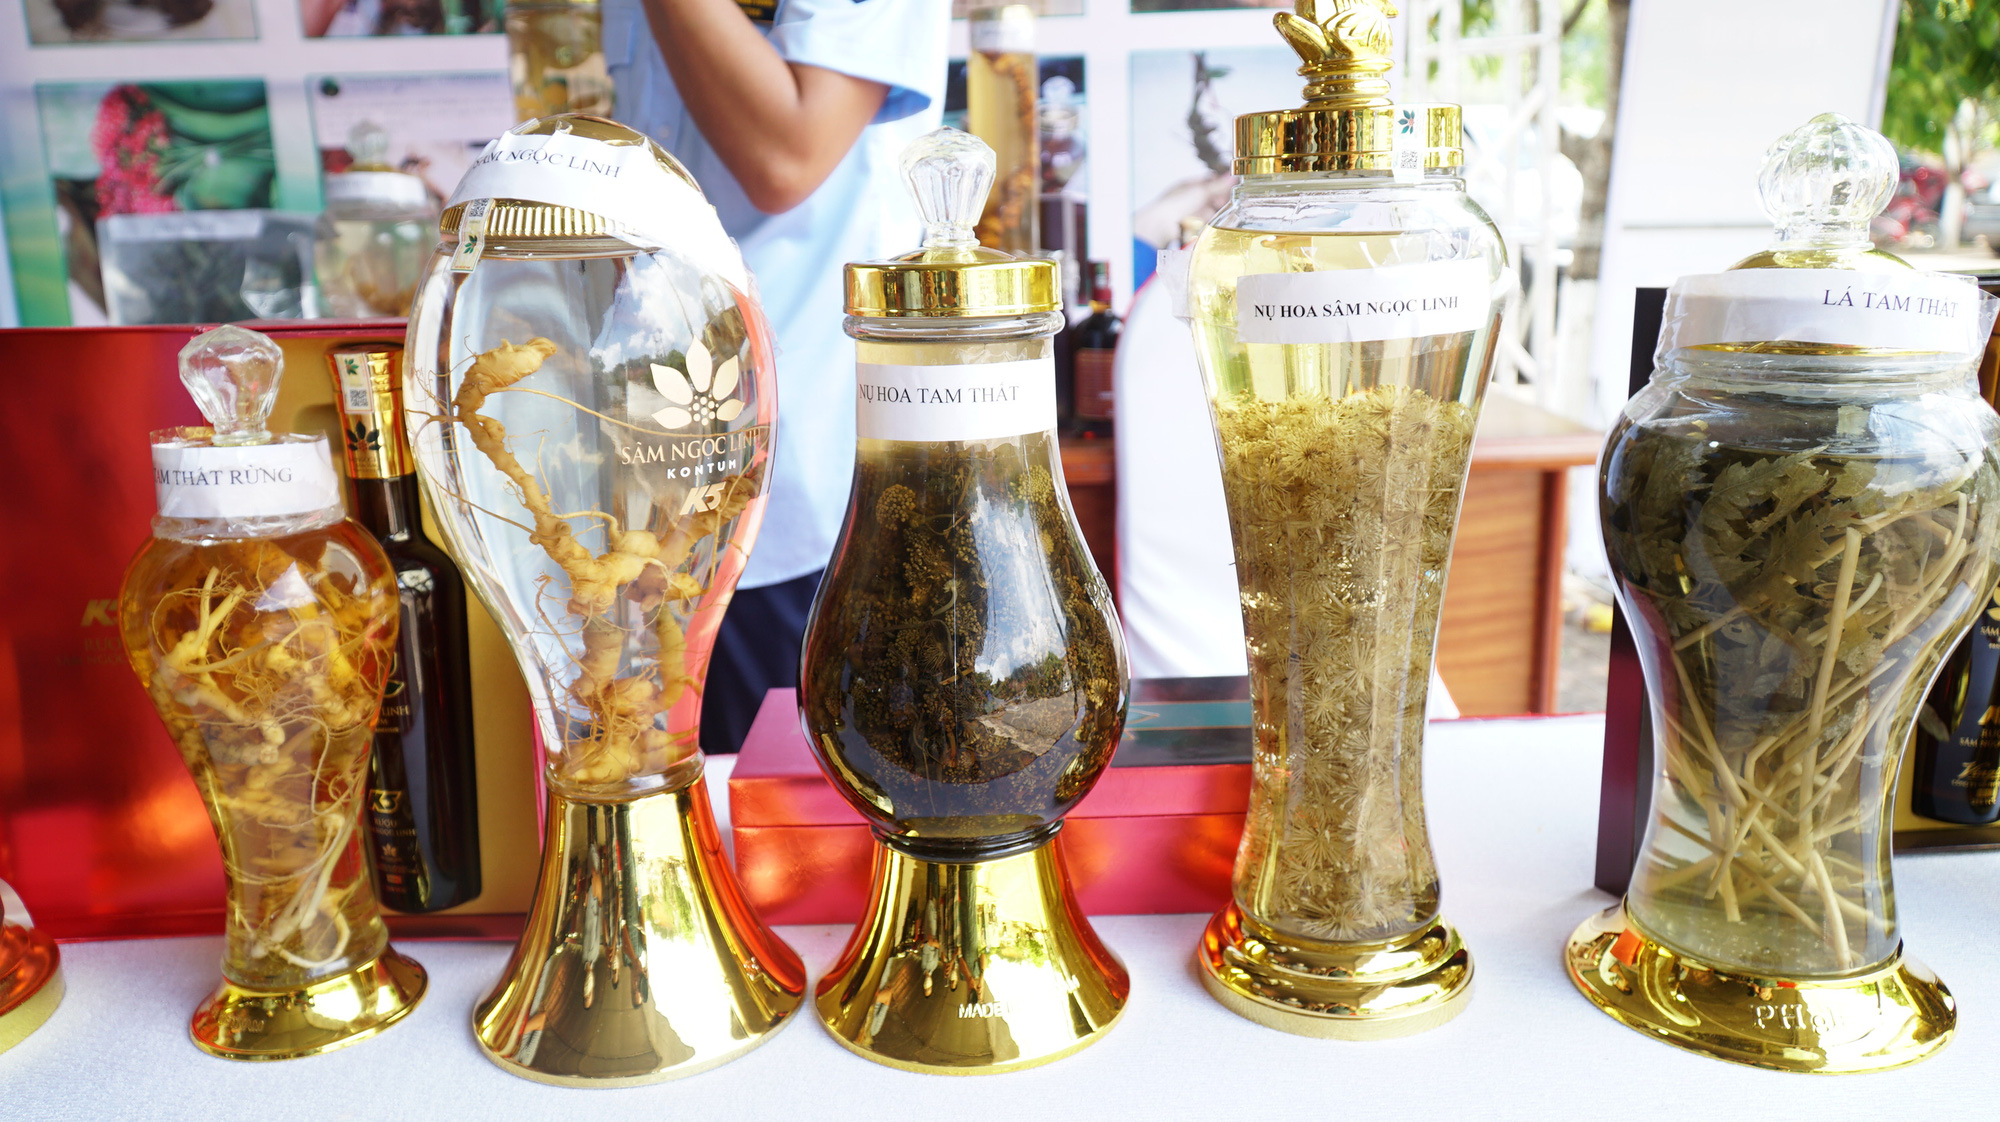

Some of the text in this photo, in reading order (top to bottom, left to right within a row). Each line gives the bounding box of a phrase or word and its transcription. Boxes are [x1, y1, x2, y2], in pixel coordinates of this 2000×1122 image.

[505, 148, 563, 165] NGỌC
[568, 156, 620, 178] LINH
[1254, 296, 1459, 321] NỤ HOA SÂM NGỌC LINH
[1822, 285, 1854, 307] LÁ
[1863, 292, 1911, 312] TAM
[859, 383, 874, 403] NỤ
[877, 386, 912, 403] HOA
[916, 388, 962, 404] TAM
[621, 441, 666, 465] SÂM
[671, 436, 727, 461] NGỌC
[230, 464, 292, 485] RỪNG
[666, 459, 737, 479] KONTUM
[679, 481, 727, 516] K5
